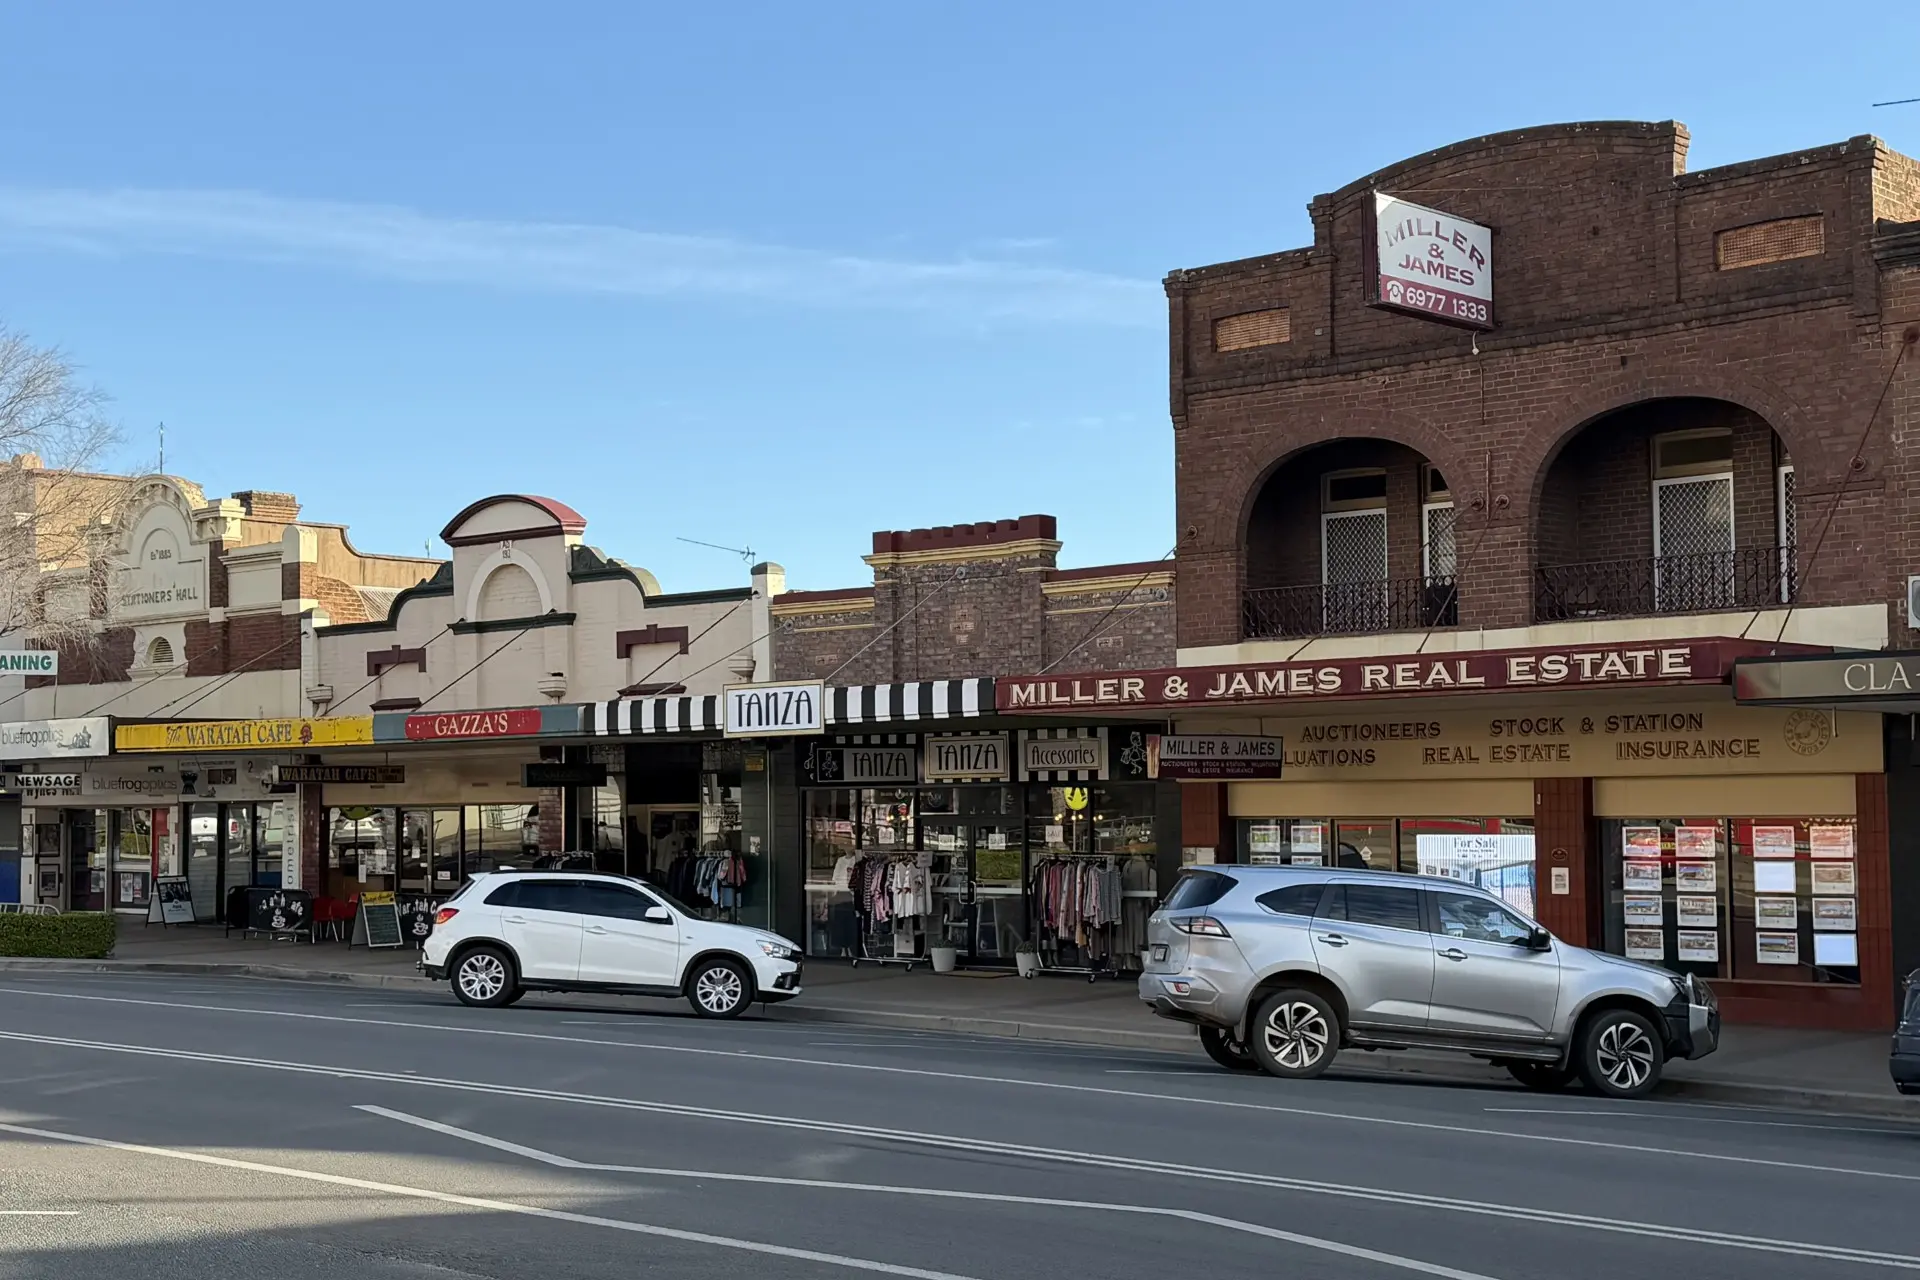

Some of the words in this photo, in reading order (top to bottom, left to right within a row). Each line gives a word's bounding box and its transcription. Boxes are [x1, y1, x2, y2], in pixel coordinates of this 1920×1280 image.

[1384, 218, 1486, 272] MILLER
[1428, 243, 1445, 261] &
[1398, 254, 1475, 287] JAMES
[1406, 287, 1446, 312] 6977
[1452, 298, 1488, 322] 1333
[175, 586, 198, 602] HALL
[0, 655, 53, 671] ANING
[1008, 677, 1146, 707] MILLER
[1163, 675, 1189, 699] &
[1205, 666, 1342, 699] JAMES
[1361, 660, 1485, 691] REAL
[1506, 647, 1692, 685] ESTATE
[1843, 661, 1920, 692] CLA
[734, 690, 813, 727] TANZA
[185, 724, 252, 745] WARATAH
[257, 722, 292, 743] CAFE
[434, 713, 508, 736] GAZZA'S
[1300, 722, 1442, 742] AUCTIONEERS
[1489, 717, 1566, 738] STOCK
[1580, 717, 1594, 735] &
[1604, 713, 1704, 734] STATION
[935, 743, 999, 771] TANZA
[1031, 744, 1095, 766] Accessories
[1166, 740, 1216, 755] MILLER
[1220, 741, 1229, 755] &
[1234, 741, 1275, 756] JAMES
[1283, 749, 1377, 767] LUATIONS
[1422, 746, 1480, 766] REAL
[1489, 743, 1571, 763] ESTATE
[1616, 738, 1761, 761] INSURANCE
[280, 767, 340, 781] WARATAH
[853, 752, 908, 777] TANZA
[14, 776, 80, 787] NEWSAGE
[1454, 837, 1472, 849] For
[1475, 836, 1498, 849] Sale
